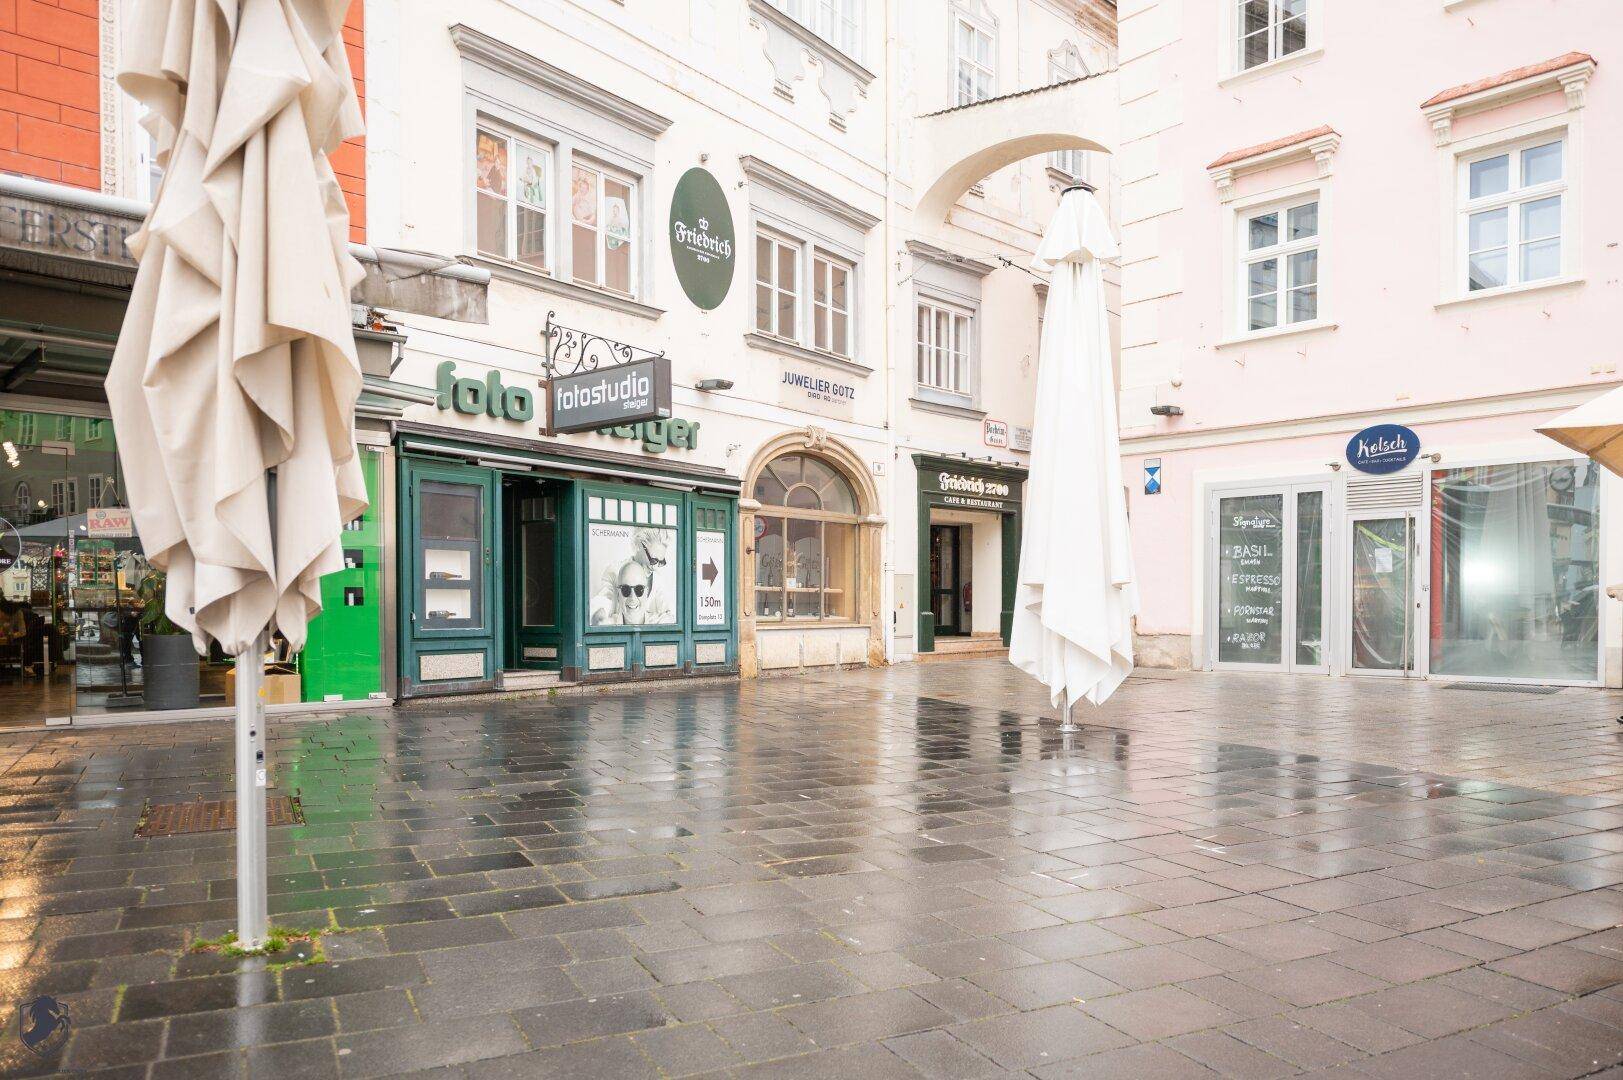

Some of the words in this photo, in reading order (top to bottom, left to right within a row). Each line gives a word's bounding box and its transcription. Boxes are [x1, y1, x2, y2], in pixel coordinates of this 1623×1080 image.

[674, 220, 732, 259] Friedrich
[782, 371, 830, 394] JUWELIER
[437, 360, 534, 423] foto
[557, 371, 650, 411] fotostudio
[622, 397, 649, 411] steiger
[938, 472, 985, 496] Friedrich
[985, 482, 1009, 496] 2700
[960, 497, 966, 505] &
[966, 498, 1004, 509] RESTAURANT
[89, 517, 128, 529] RAW
[1233, 515, 1271, 529] Signature
[592, 528, 629, 538] SCHERMANN
[1232, 544, 1273, 559] BASIL
[1232, 573, 1281, 586] ESPRESSO
[699, 596, 722, 608] 150m
[1233, 605, 1275, 617] PORNSTAR
